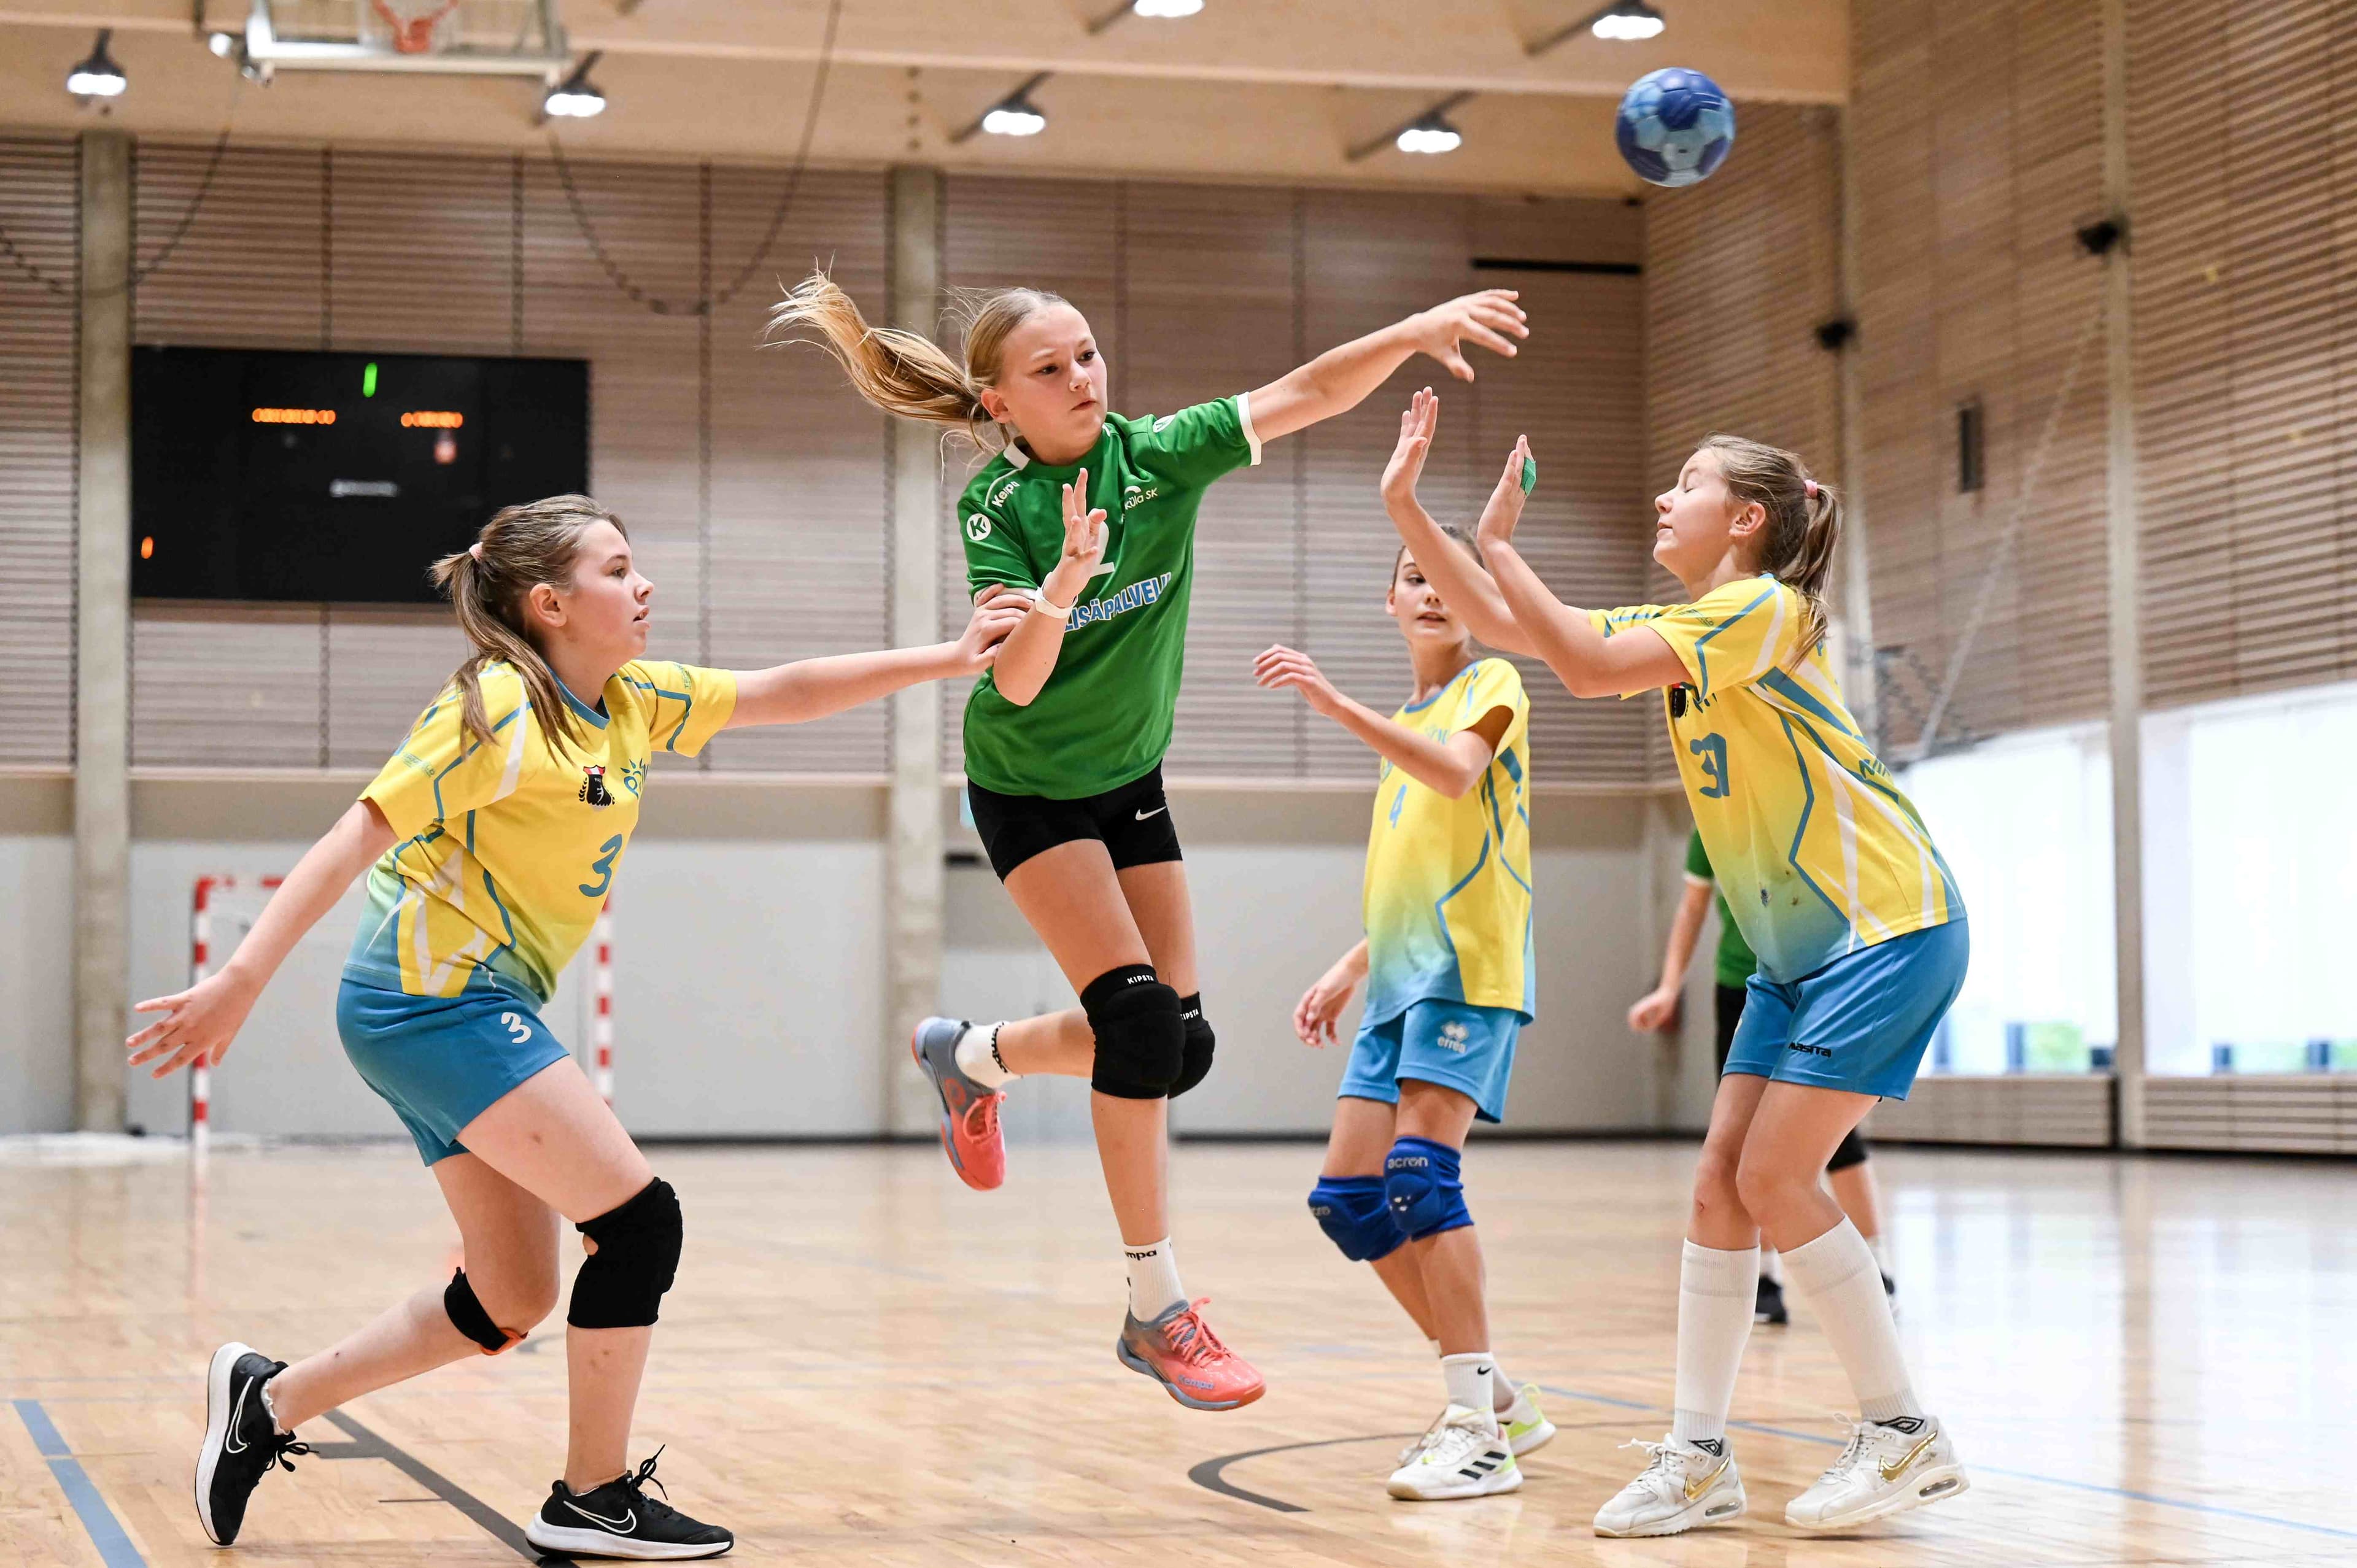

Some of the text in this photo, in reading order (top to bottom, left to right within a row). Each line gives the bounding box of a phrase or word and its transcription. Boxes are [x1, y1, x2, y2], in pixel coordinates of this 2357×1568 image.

[1145, 487, 1158, 500] SK
[1389, 784, 1407, 828] 4
[579, 833, 622, 897] 3
[1127, 975, 1154, 984] KIPSTA
[501, 1012, 532, 1043] 3
